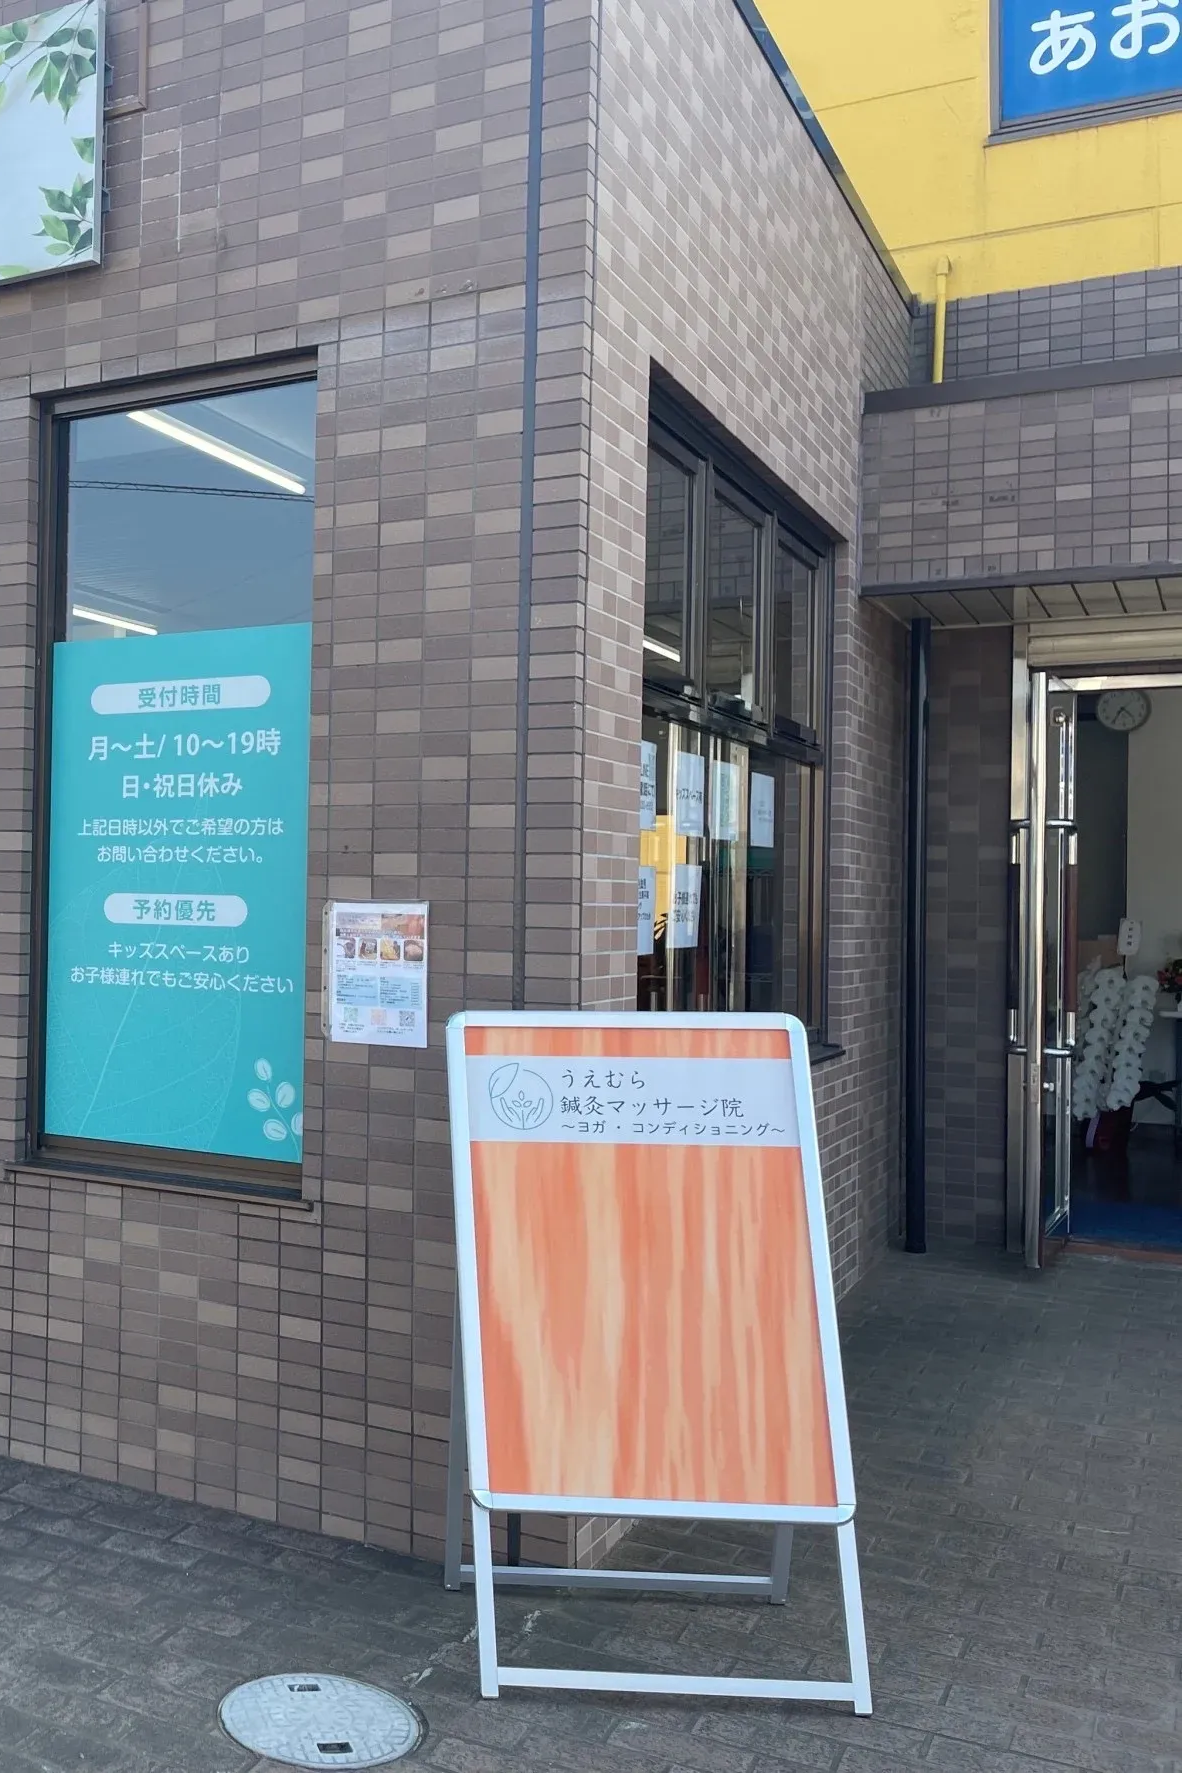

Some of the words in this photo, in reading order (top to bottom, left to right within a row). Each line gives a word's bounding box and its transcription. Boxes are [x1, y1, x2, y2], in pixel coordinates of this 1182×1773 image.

[137, 684, 221, 709] 受付時間
[122, 772, 243, 799] 日・祝日休み
[77, 817, 284, 837] 上記日時以外でご希望の方は
[97, 845, 263, 864] お問い合わせください。
[132, 899, 216, 922] 予約優先
[108, 941, 250, 964] キッズスペースあり
[70, 966, 294, 993] お子様連れでもご安心ください
[562, 1069, 646, 1090] うえむら
[560, 1096, 744, 1118] 鍼灸マッサージ院
